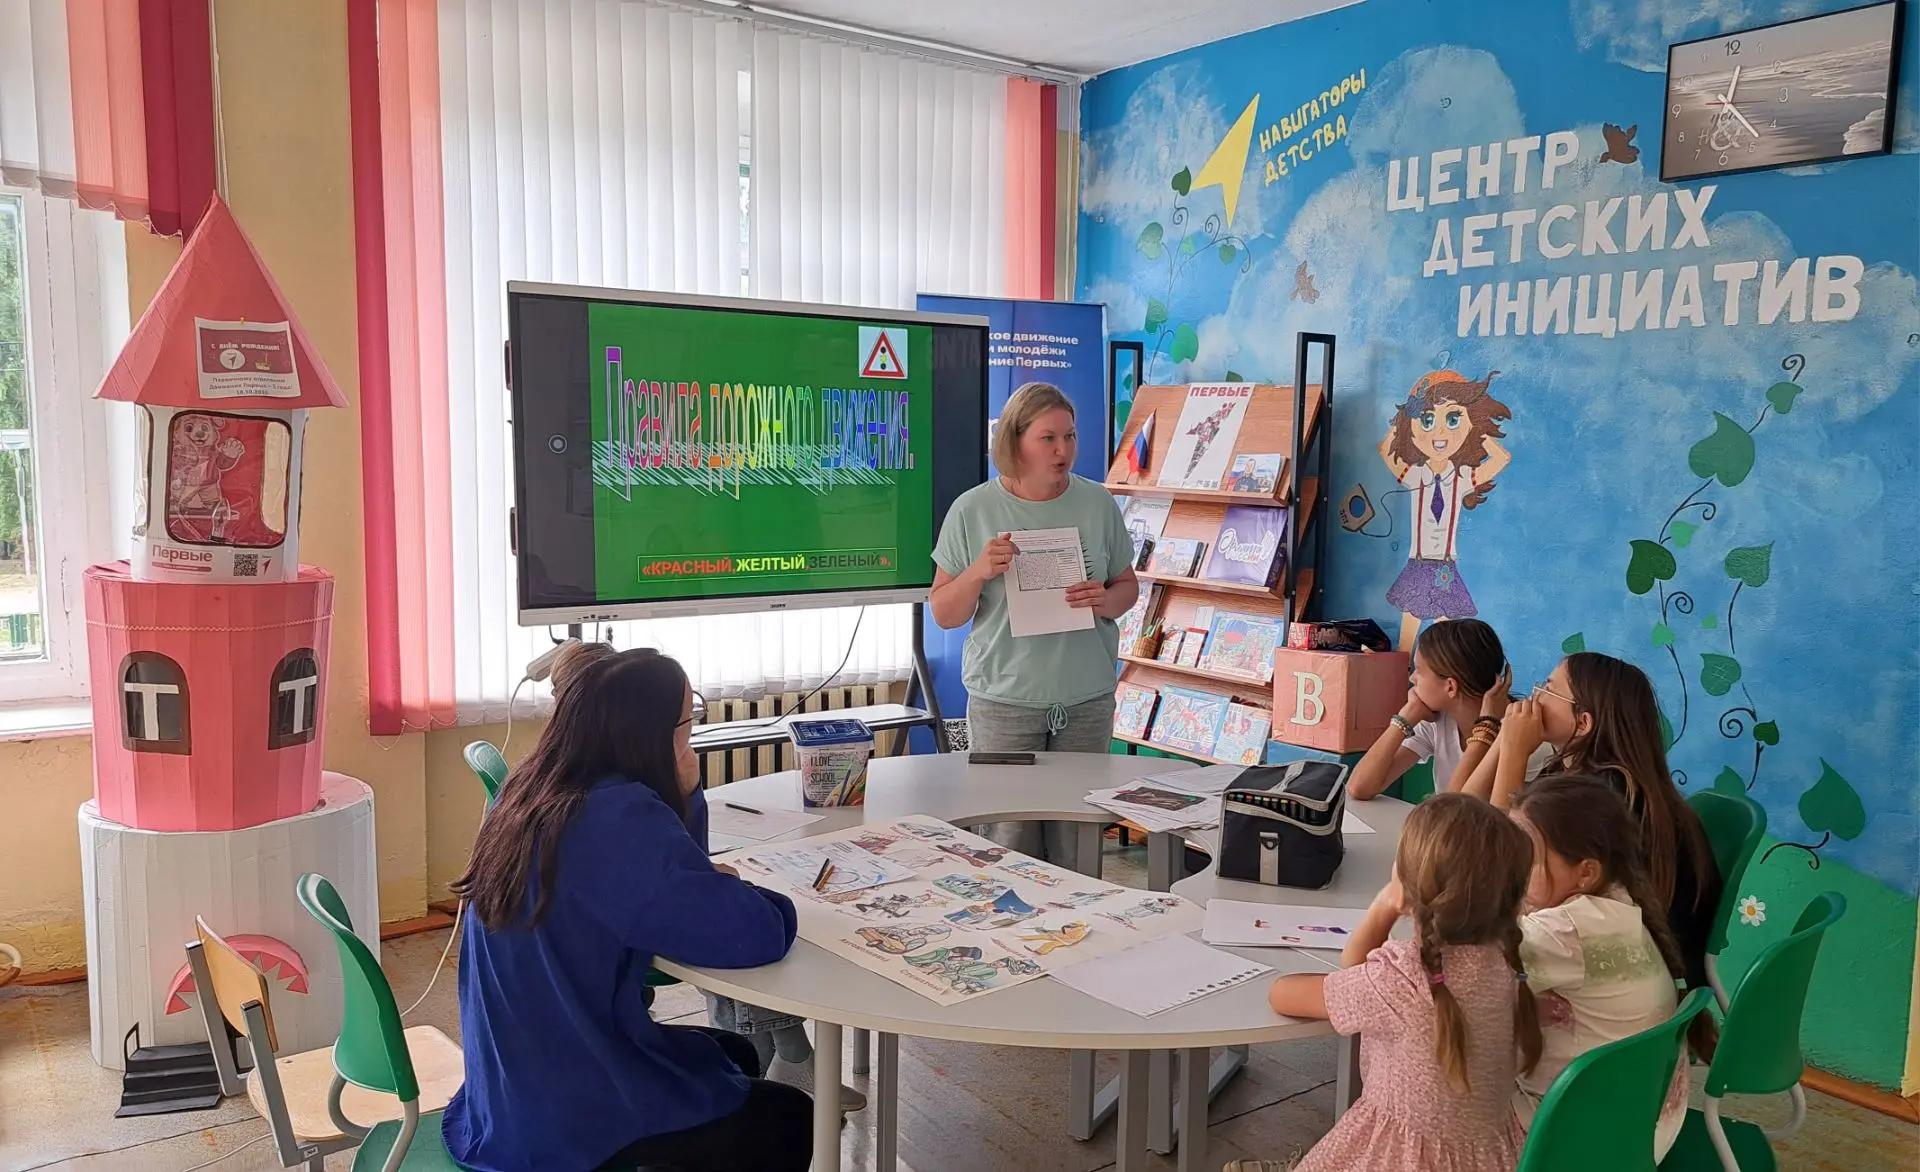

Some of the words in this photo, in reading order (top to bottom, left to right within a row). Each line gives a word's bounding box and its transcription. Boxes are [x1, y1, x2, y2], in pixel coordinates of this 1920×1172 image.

[1723, 40, 1741, 56] 12
[1778, 87, 1789, 103] 3
[1259, 68, 1366, 153] НАВИГАТОРЫ
[1671, 104, 1681, 118] 9
[1769, 119, 1777, 128] 4
[1265, 114, 1347, 187] ДЕТСТВА
[1718, 152, 1729, 166] 6
[1386, 131, 1580, 212] ЦЕНТР
[1423, 185, 1718, 278] ДЕТСКИХ
[1456, 254, 1865, 338] ИНИЦИАТИВ
[1013, 333, 1079, 345] движение
[998, 345, 1066, 356] молодёжи
[1190, 387, 1250, 397] ПЕРВЫЕ
[606, 346, 701, 501] Правила
[708, 382, 815, 500] дорожного
[820, 388, 914, 490] движения.
[152, 544, 213, 562] Первые
[810, 772, 836, 783] SCHOOL
